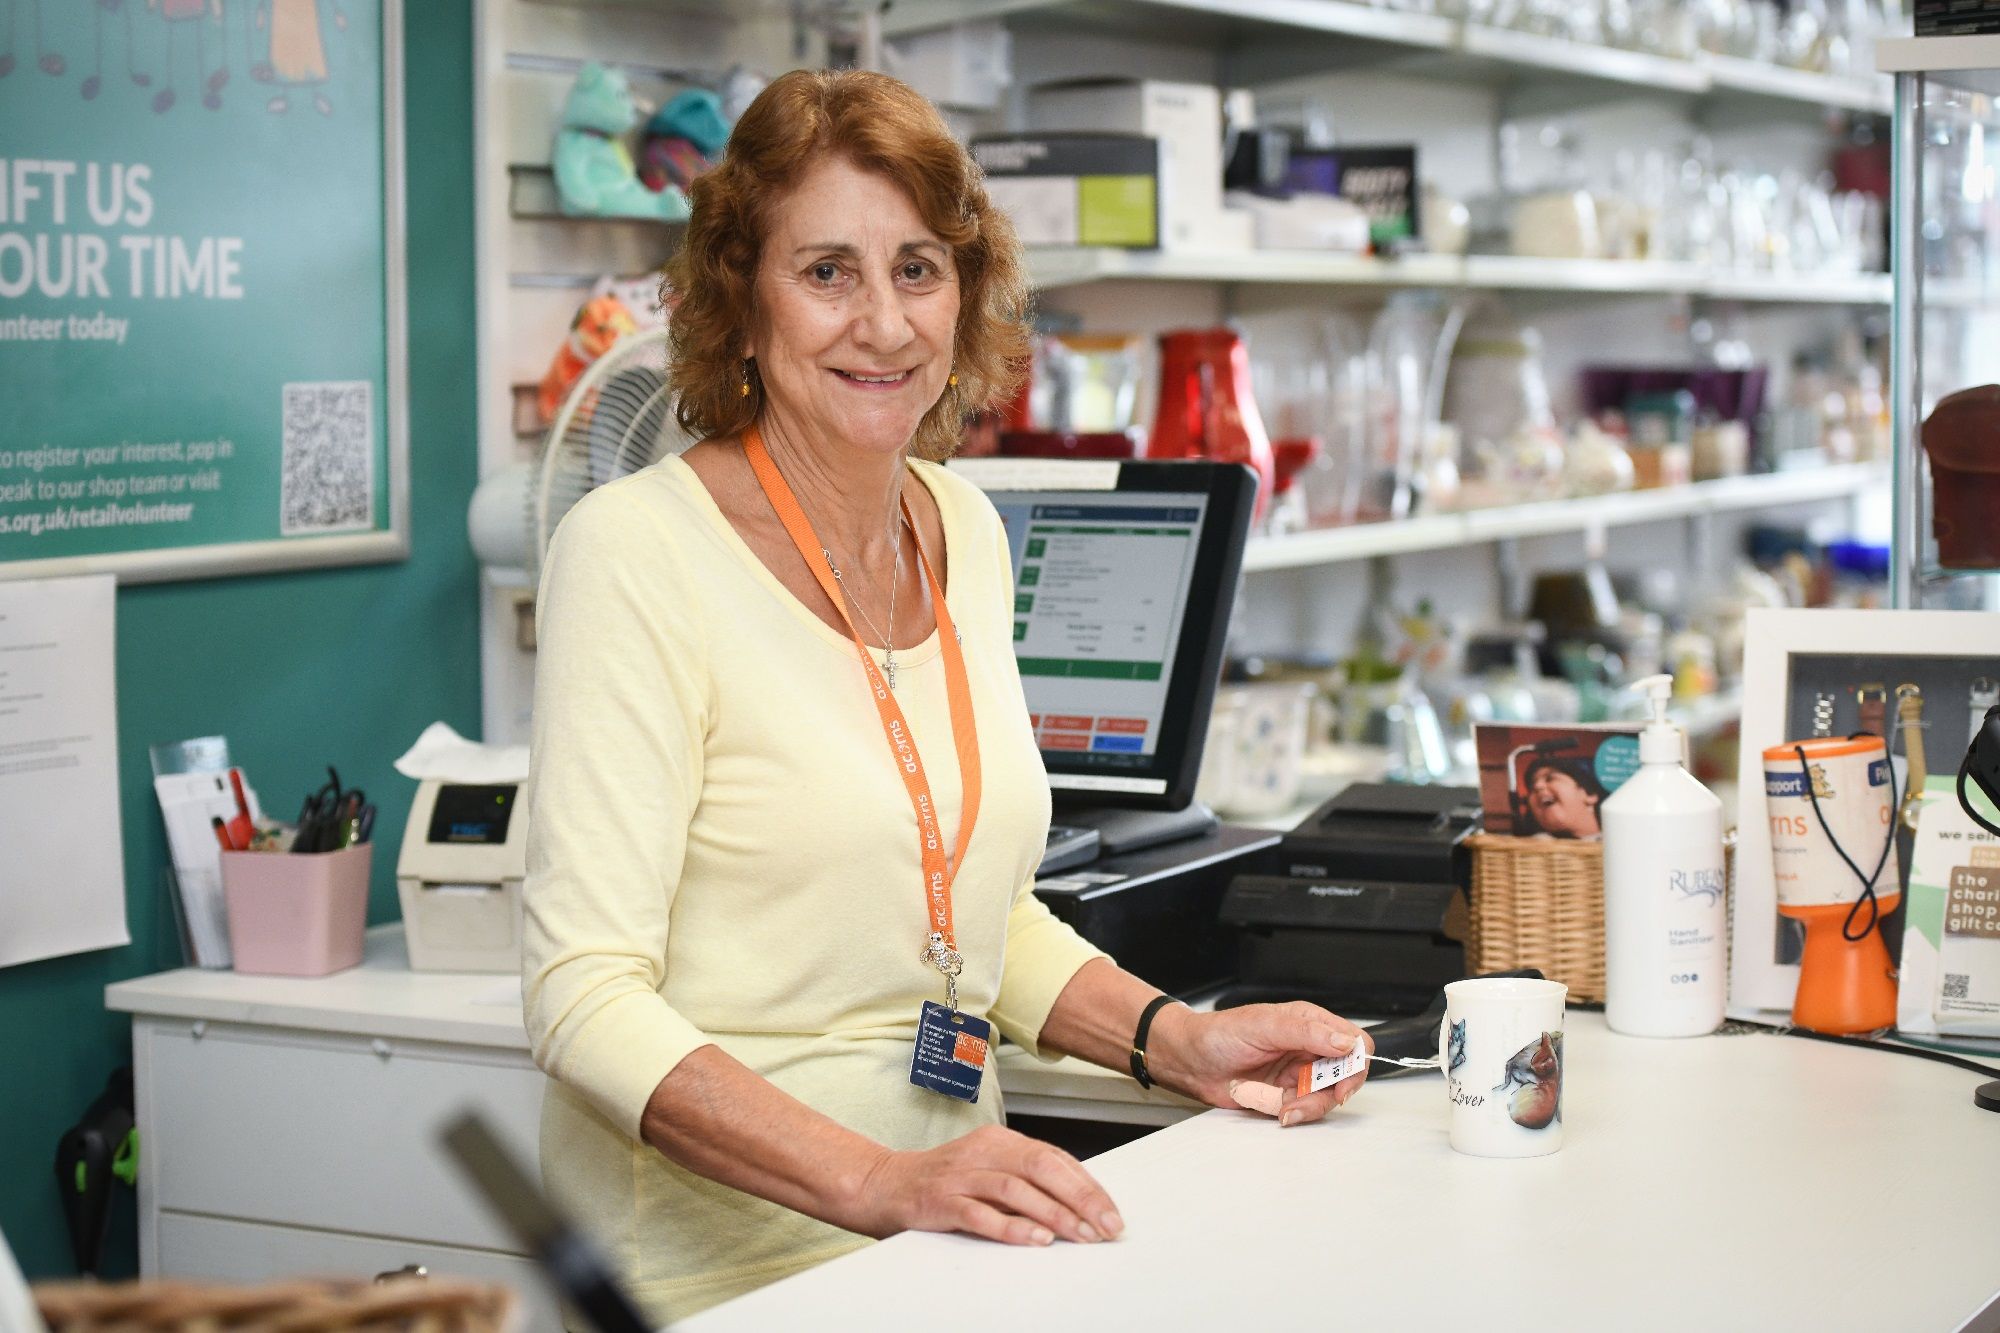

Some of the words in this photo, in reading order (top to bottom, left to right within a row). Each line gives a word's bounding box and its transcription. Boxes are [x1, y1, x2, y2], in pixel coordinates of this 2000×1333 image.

[86, 161, 153, 227] US
[0, 232, 111, 299] OUR
[119, 234, 245, 299] TIME
[67, 310, 128, 344] today
[16, 443, 80, 472] register
[83, 446, 119, 469] your
[186, 441, 215, 465] pop
[217, 435, 234, 458] in
[38, 479, 54, 499] to
[58, 480, 86, 499] our
[88, 474, 126, 498] shop
[129, 474, 169, 495] team
[171, 474, 188, 493] or
[189, 468, 220, 491] visit
[1938, 831, 1962, 840] we
[1956, 872, 1988, 888] the
[931, 872, 947, 927] acorns
[1951, 902, 1996, 918] shop
[1949, 917, 1981, 932] gift
